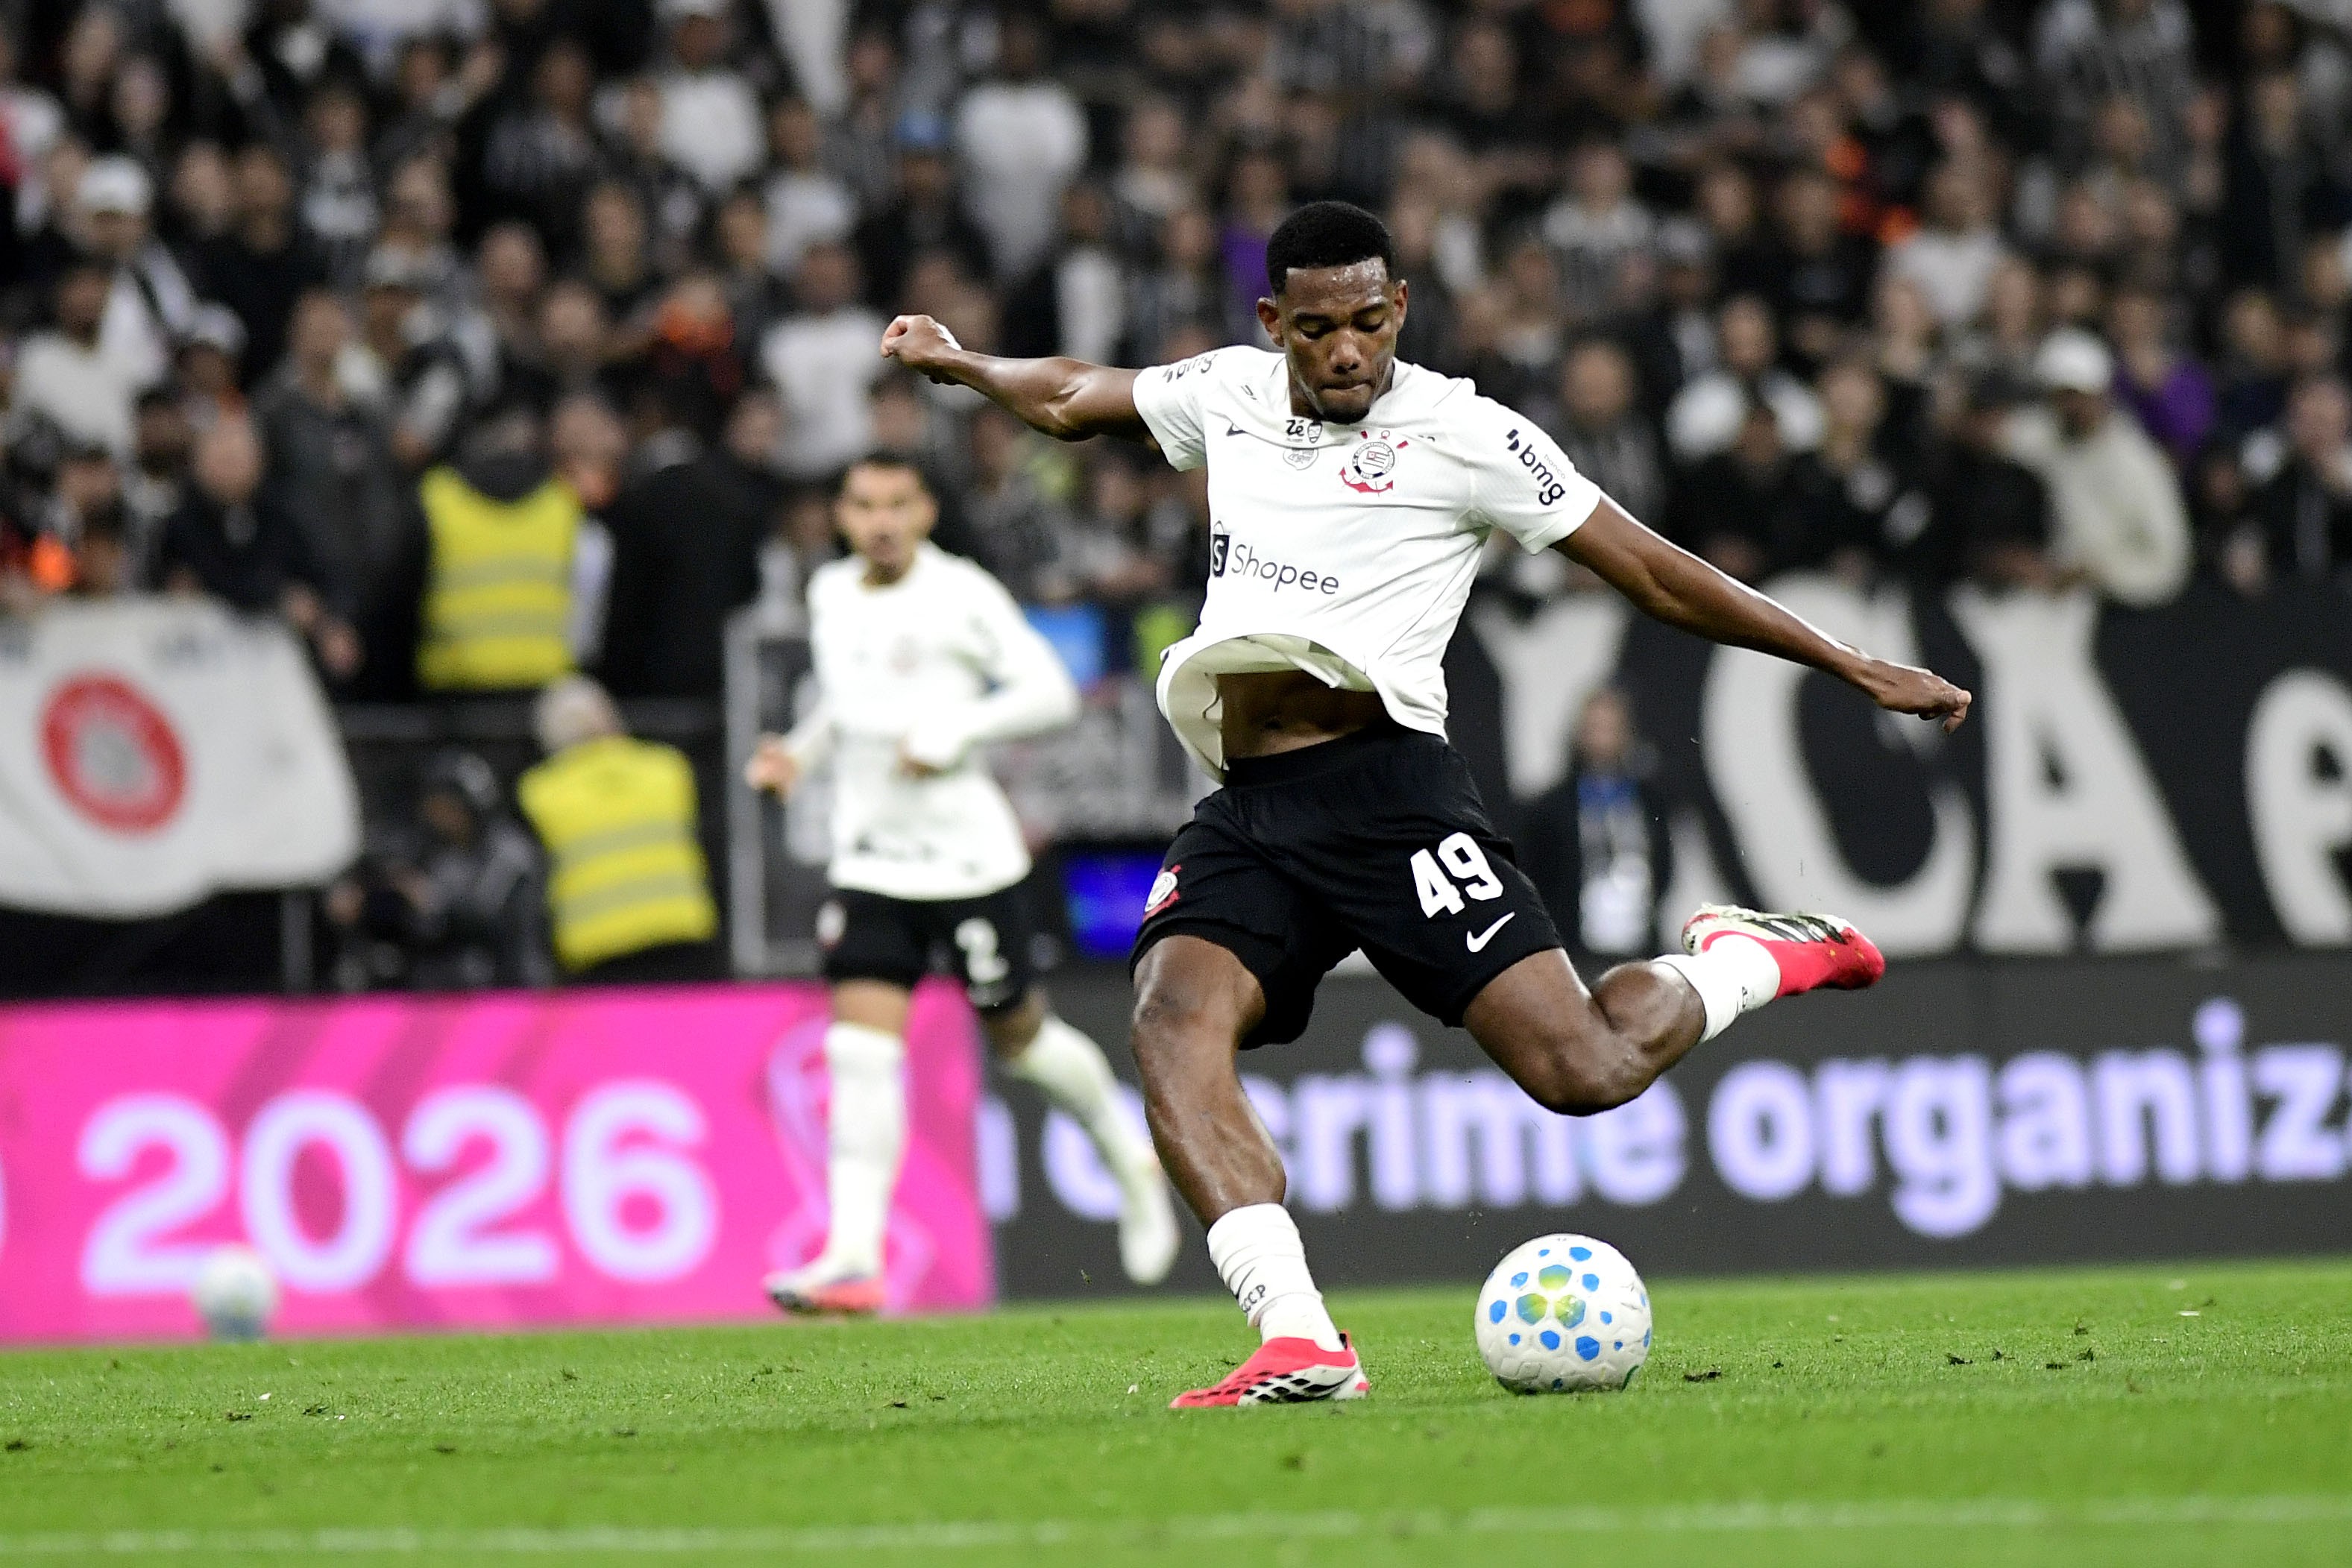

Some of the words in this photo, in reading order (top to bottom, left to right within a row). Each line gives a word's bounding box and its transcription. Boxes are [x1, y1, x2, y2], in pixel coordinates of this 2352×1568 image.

[1286, 419, 1305, 437] Zé
[1518, 444, 1566, 506] bmg
[1544, 453, 1566, 479] banco
[1231, 544, 1339, 595] Shopee
[1410, 831, 1503, 918] 49
[1706, 996, 2352, 1239] organiz
[78, 1077, 719, 1296] 2026
